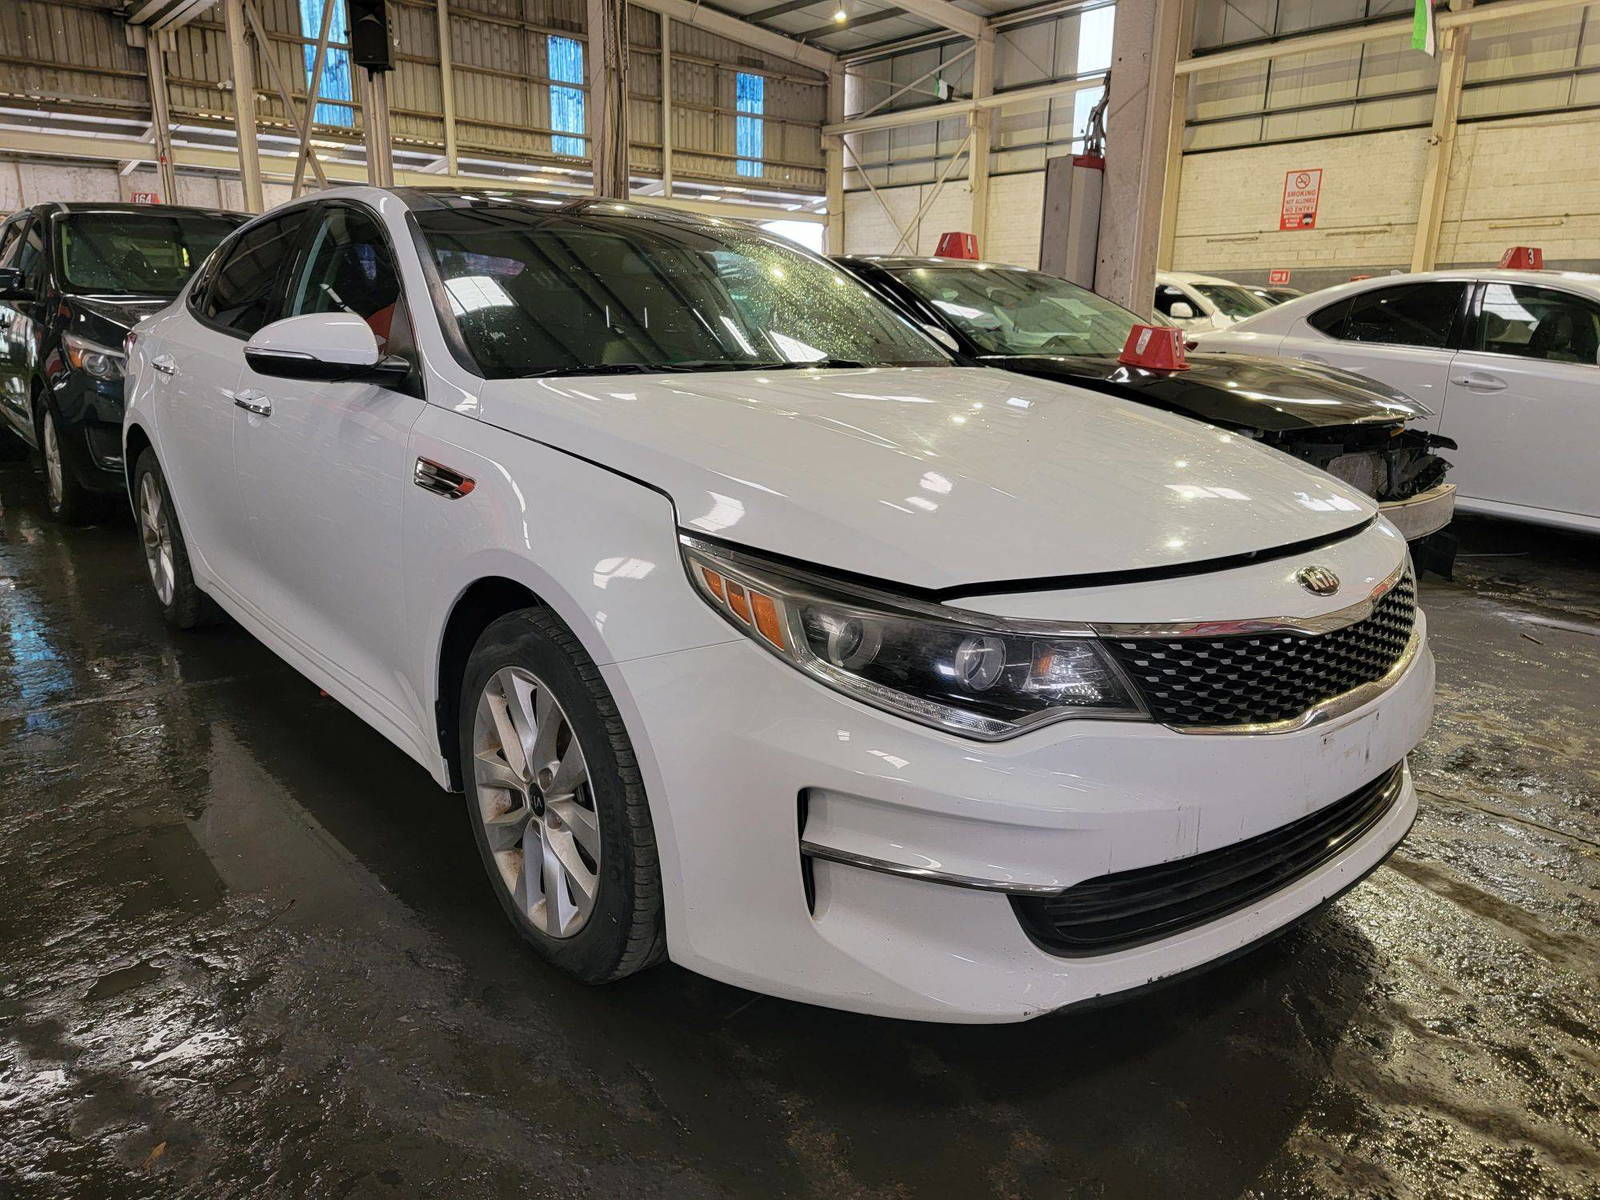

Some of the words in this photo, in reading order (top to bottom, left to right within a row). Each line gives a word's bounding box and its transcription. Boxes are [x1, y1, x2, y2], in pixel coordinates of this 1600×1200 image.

[134, 193, 152, 203] 164
[1528, 248, 1535, 265] 3
[1303, 569, 1338, 590] KIA
